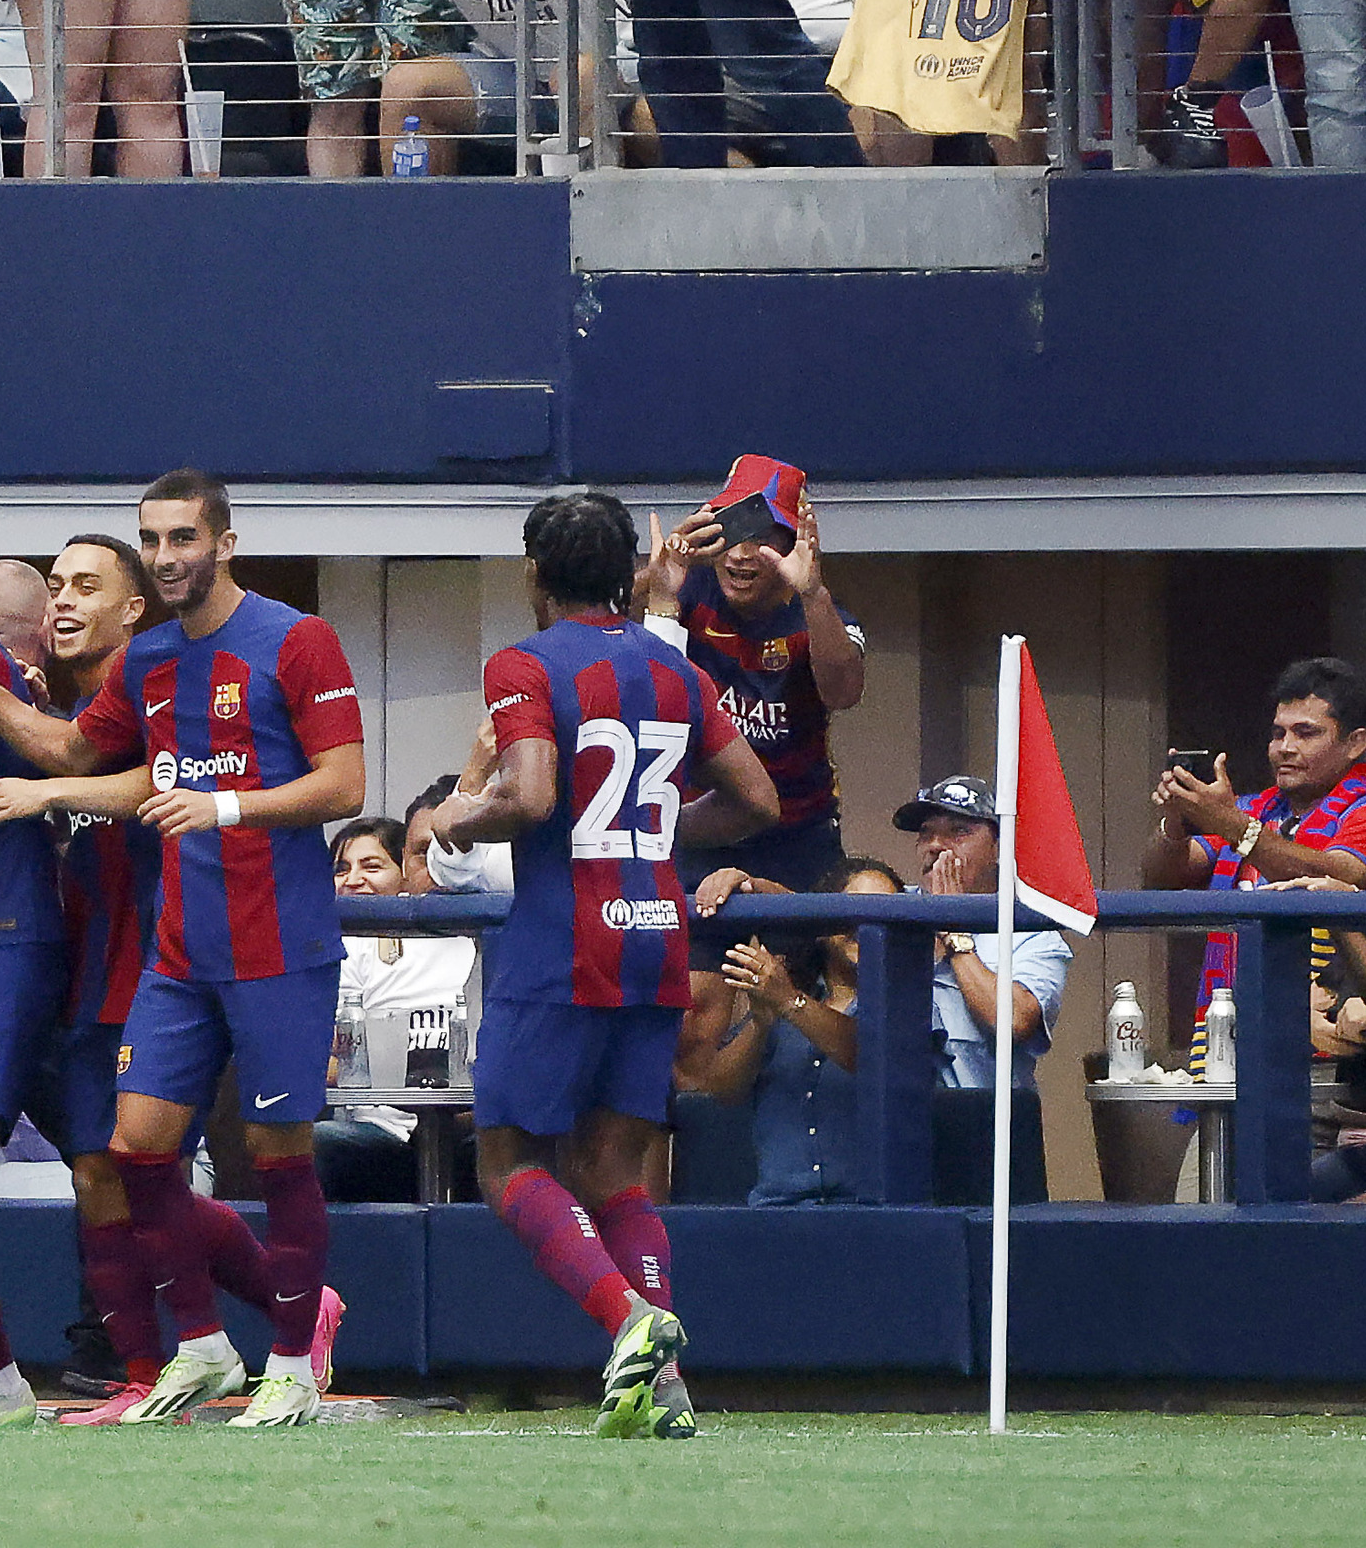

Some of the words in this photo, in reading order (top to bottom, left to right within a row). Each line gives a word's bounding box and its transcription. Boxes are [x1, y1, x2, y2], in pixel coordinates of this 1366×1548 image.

[180, 751, 248, 782] Spotify
[572, 718, 692, 861] 23
[636, 911, 680, 926] ACNUR
